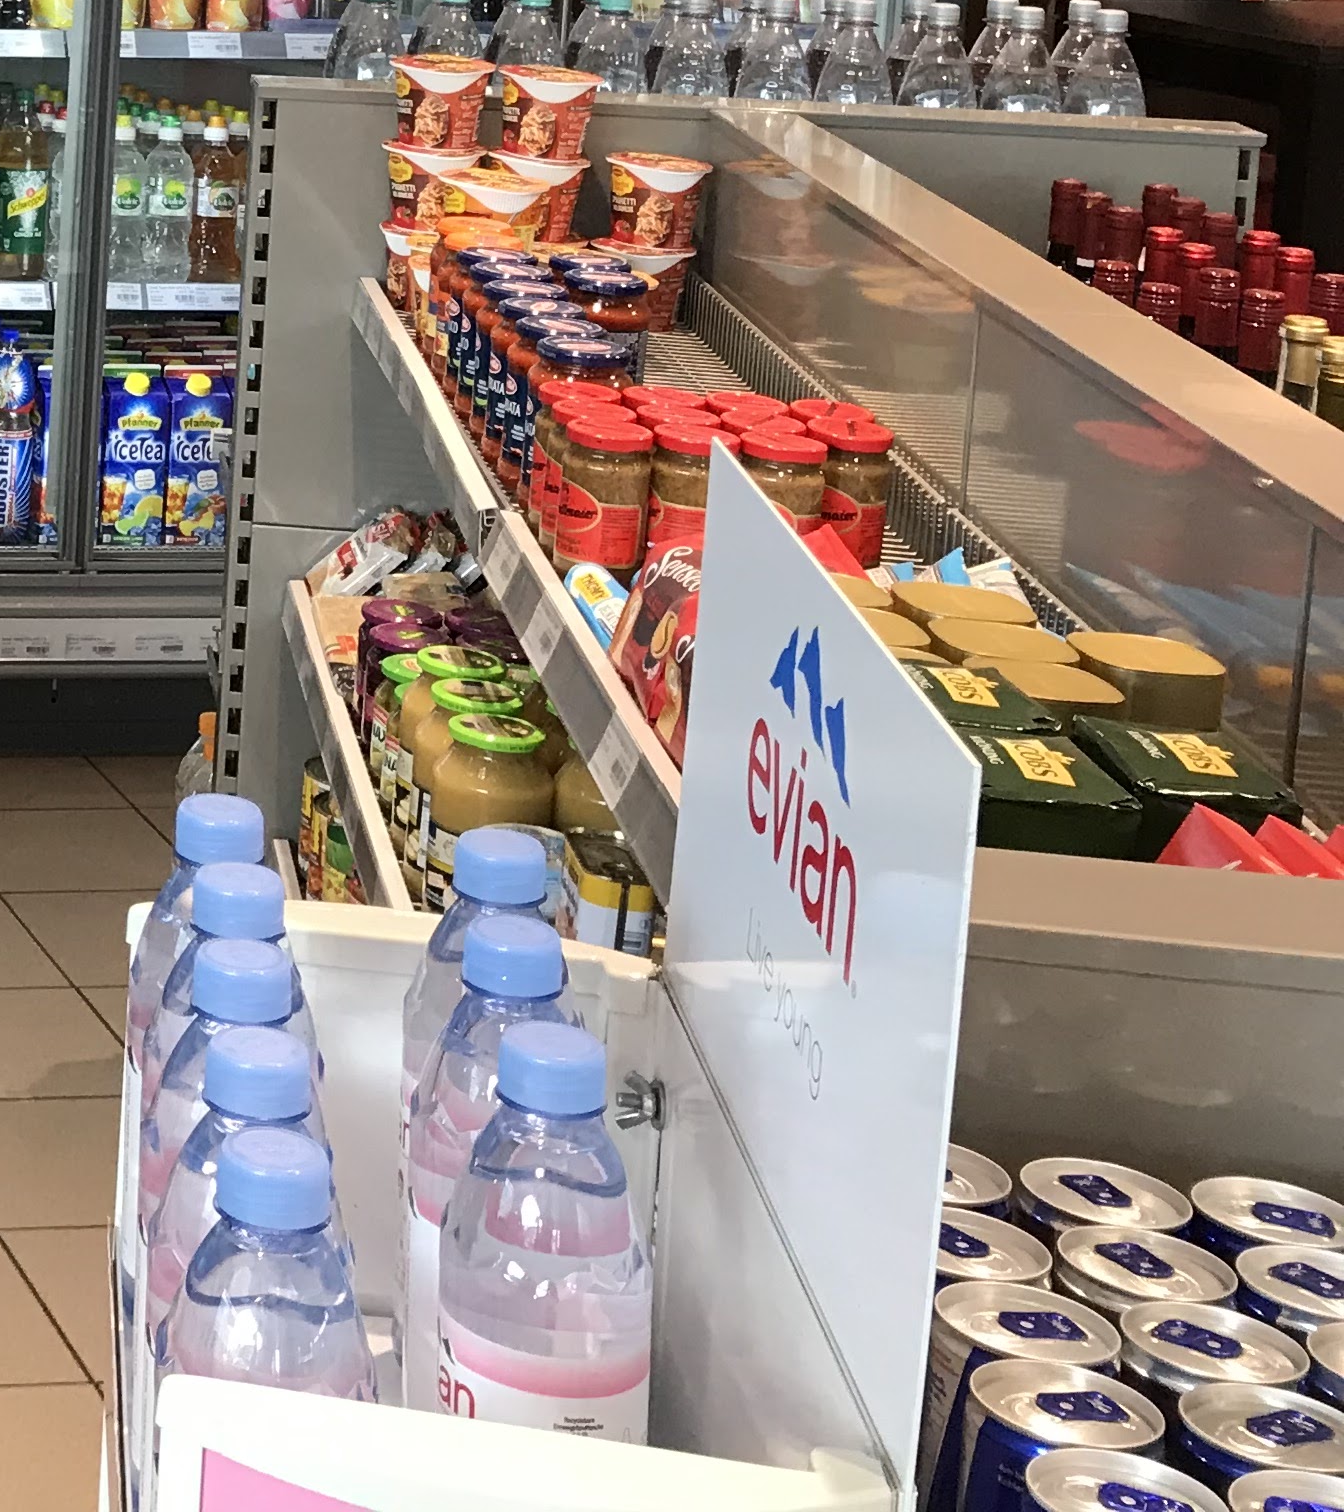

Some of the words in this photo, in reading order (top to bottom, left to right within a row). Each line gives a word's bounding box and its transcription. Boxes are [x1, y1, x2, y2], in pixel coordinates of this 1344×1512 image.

[747, 717, 858, 986] evian
[745, 908, 775, 993] Live
[773, 981, 823, 1101] young
